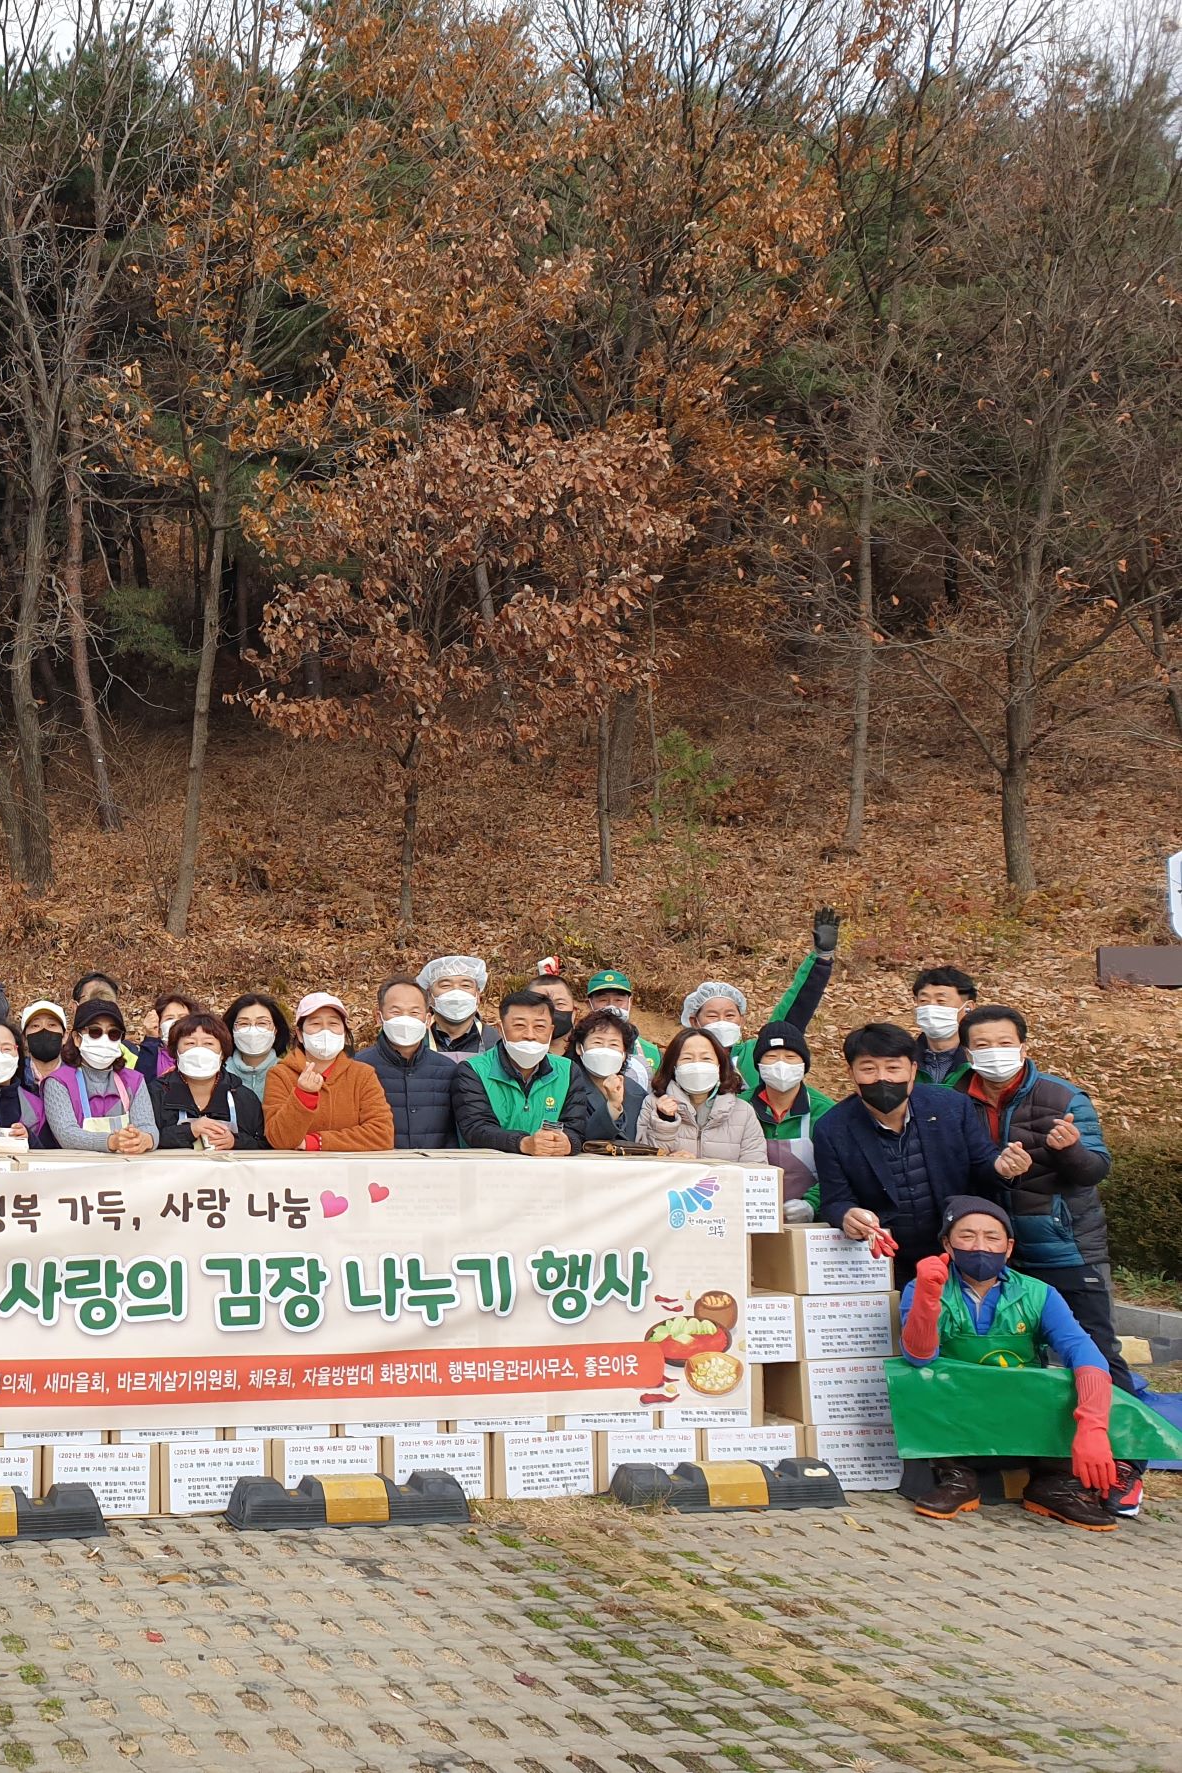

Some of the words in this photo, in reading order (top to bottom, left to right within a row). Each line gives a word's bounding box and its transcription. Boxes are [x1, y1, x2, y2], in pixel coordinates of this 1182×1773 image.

[58, 1191, 141, 1232] 가득,
[160, 1188, 231, 1229] 사랑
[247, 1188, 311, 1229] 나눔
[0, 1260, 184, 1330] 사랑의
[206, 1257, 328, 1328] 김장
[345, 1256, 513, 1322] 나누기
[531, 1250, 649, 1320] 행사
[43, 1371, 110, 1393] 새마을회,
[117, 1369, 242, 1393] 바르게살기위원회,
[248, 1368, 297, 1389] 체육회,
[302, 1364, 375, 1386] 자율방범대
[380, 1361, 444, 1385] 화랑지대,
[448, 1358, 580, 1383] 행복마을관리사무소,
[584, 1354, 640, 1378] 좋은이웃
